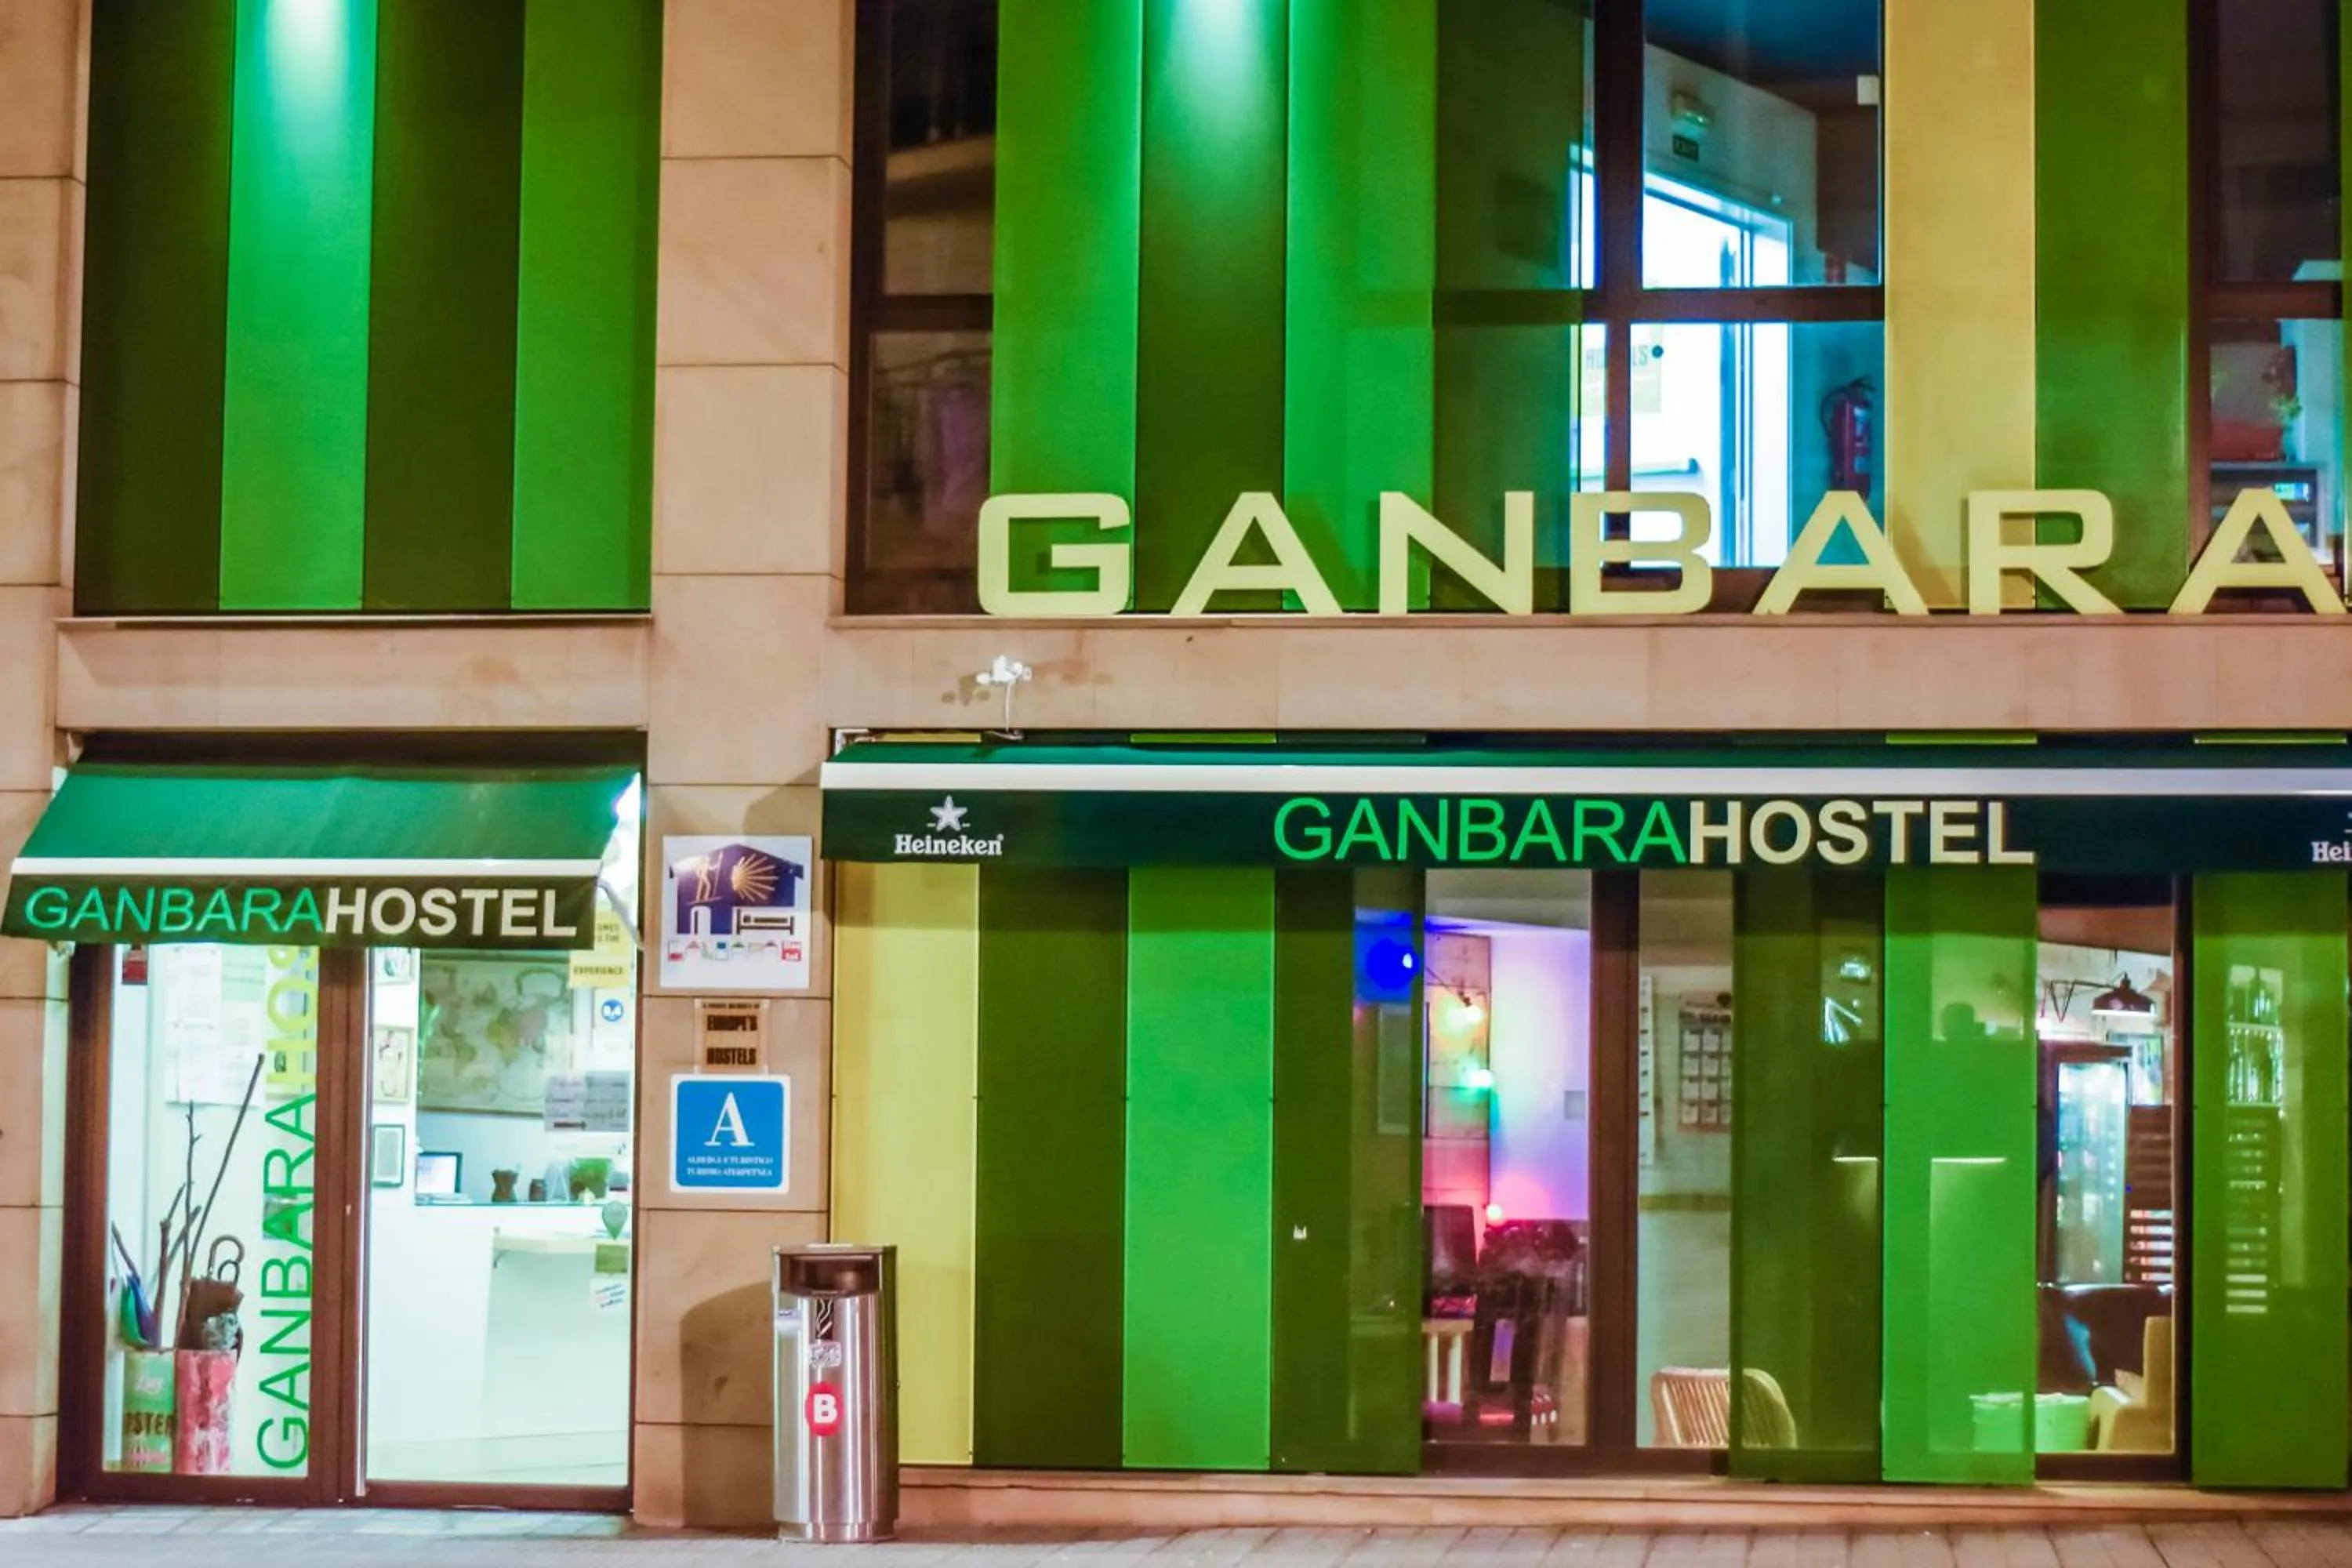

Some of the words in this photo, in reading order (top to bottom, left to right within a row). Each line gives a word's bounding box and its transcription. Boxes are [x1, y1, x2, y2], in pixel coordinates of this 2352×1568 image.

[978, 488, 2348, 615] GANBARA
[894, 834, 1003, 855] Heineken
[2310, 840, 2352, 862] Hei
[706, 1047, 757, 1065] HOSTELS
[704, 1091, 755, 1147] A
[813, 1393, 838, 1424] B
